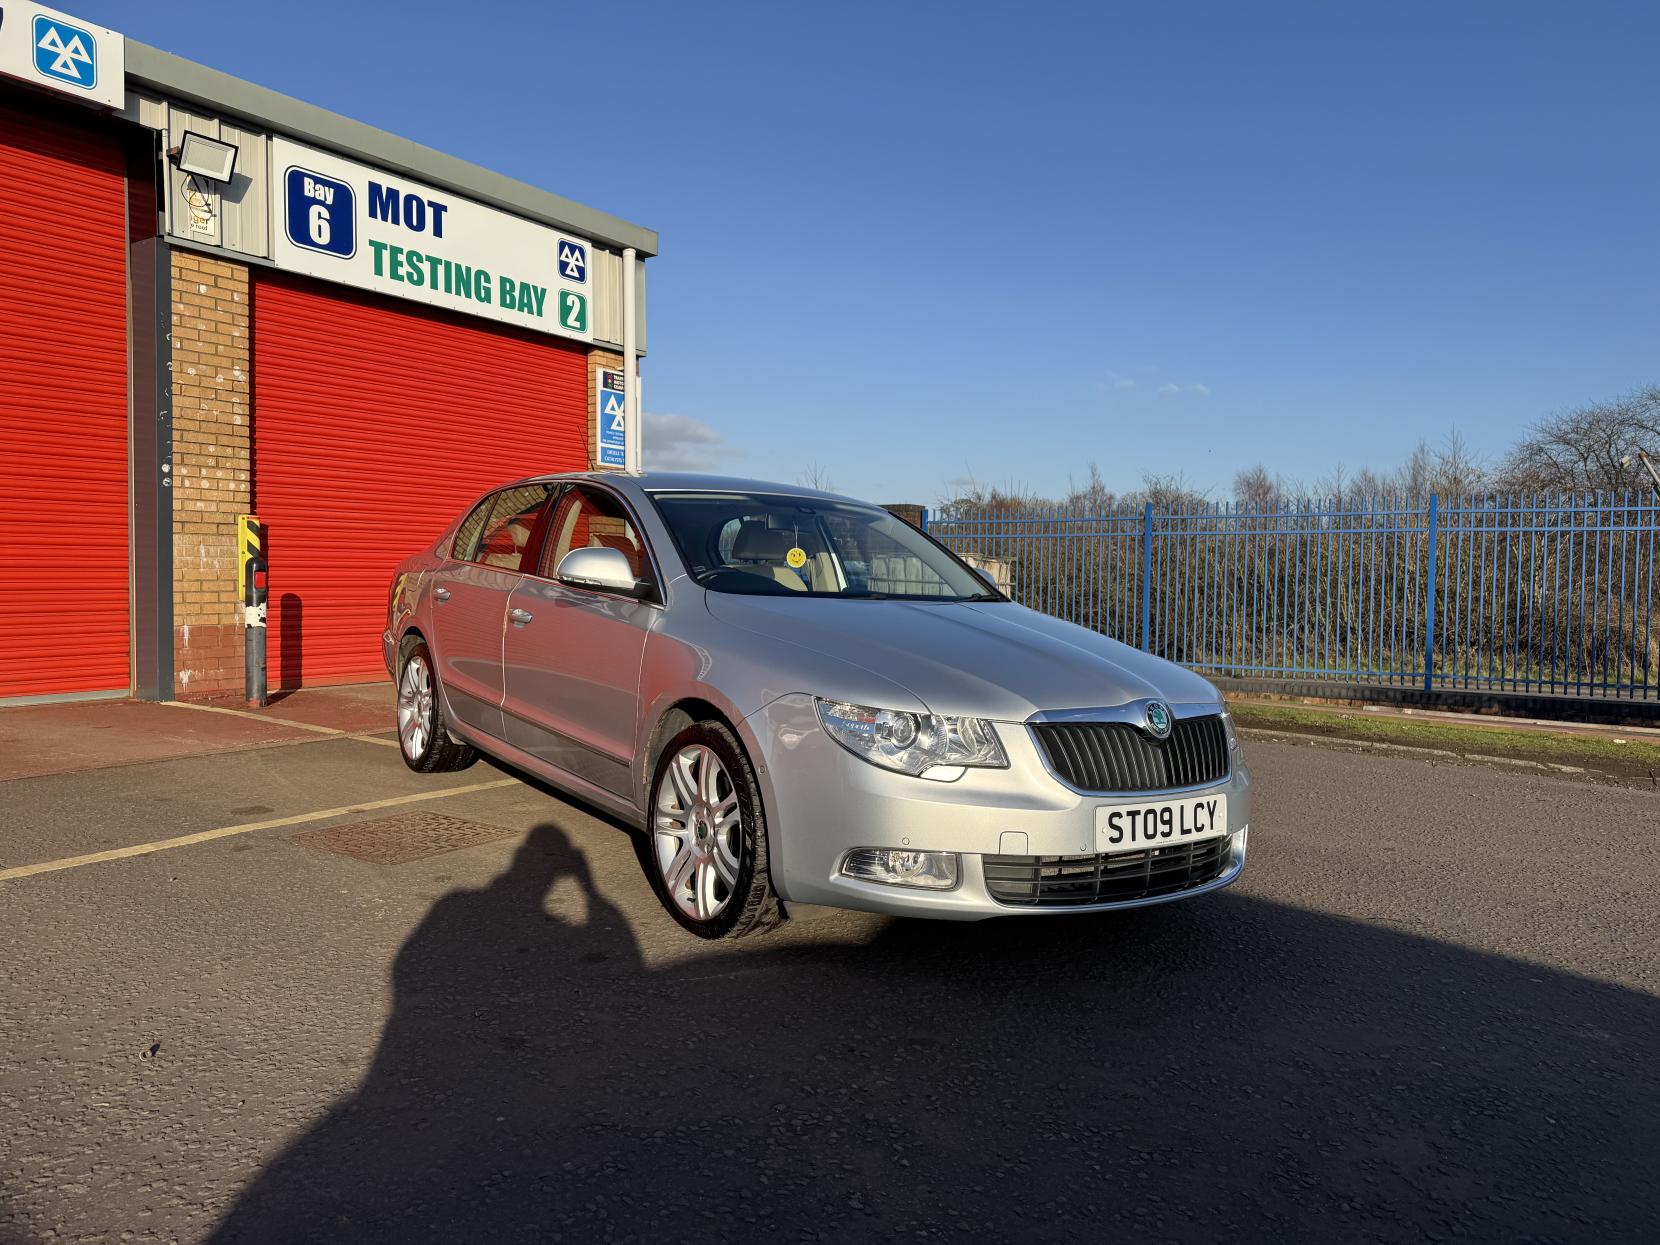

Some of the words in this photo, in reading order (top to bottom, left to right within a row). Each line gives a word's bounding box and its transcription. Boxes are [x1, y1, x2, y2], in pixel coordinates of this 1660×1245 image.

[304, 177, 334, 205] Bay
[368, 181, 447, 238] MOT
[309, 204, 330, 245] 6
[368, 239, 492, 304] TESTING
[499, 275, 547, 318] BAY
[565, 294, 581, 328] 2
[1108, 807, 1173, 843] ST09
[1180, 800, 1217, 836] LCY
